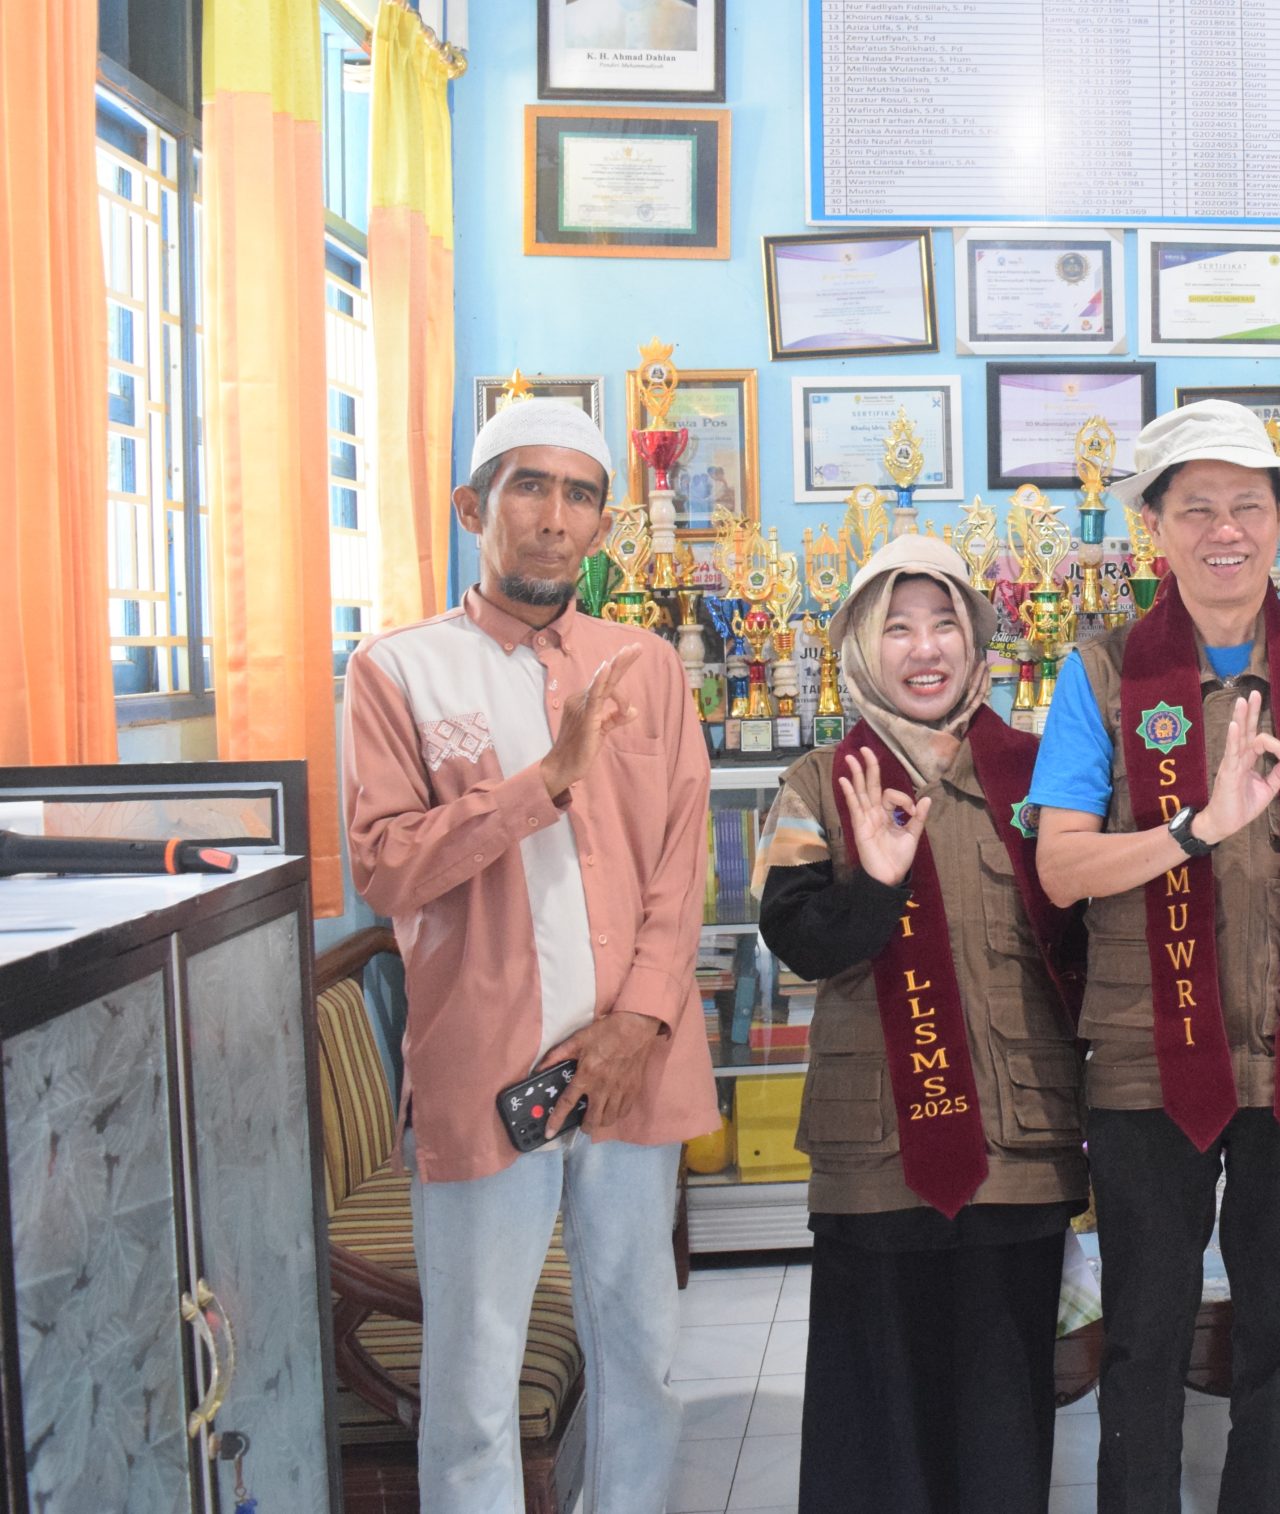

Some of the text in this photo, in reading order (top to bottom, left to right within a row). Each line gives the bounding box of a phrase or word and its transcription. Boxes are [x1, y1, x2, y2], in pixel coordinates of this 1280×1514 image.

[612, 53, 642, 61] Ahmad
[703, 418, 728, 428] Pos
[910, 1096, 970, 1120] 2025
